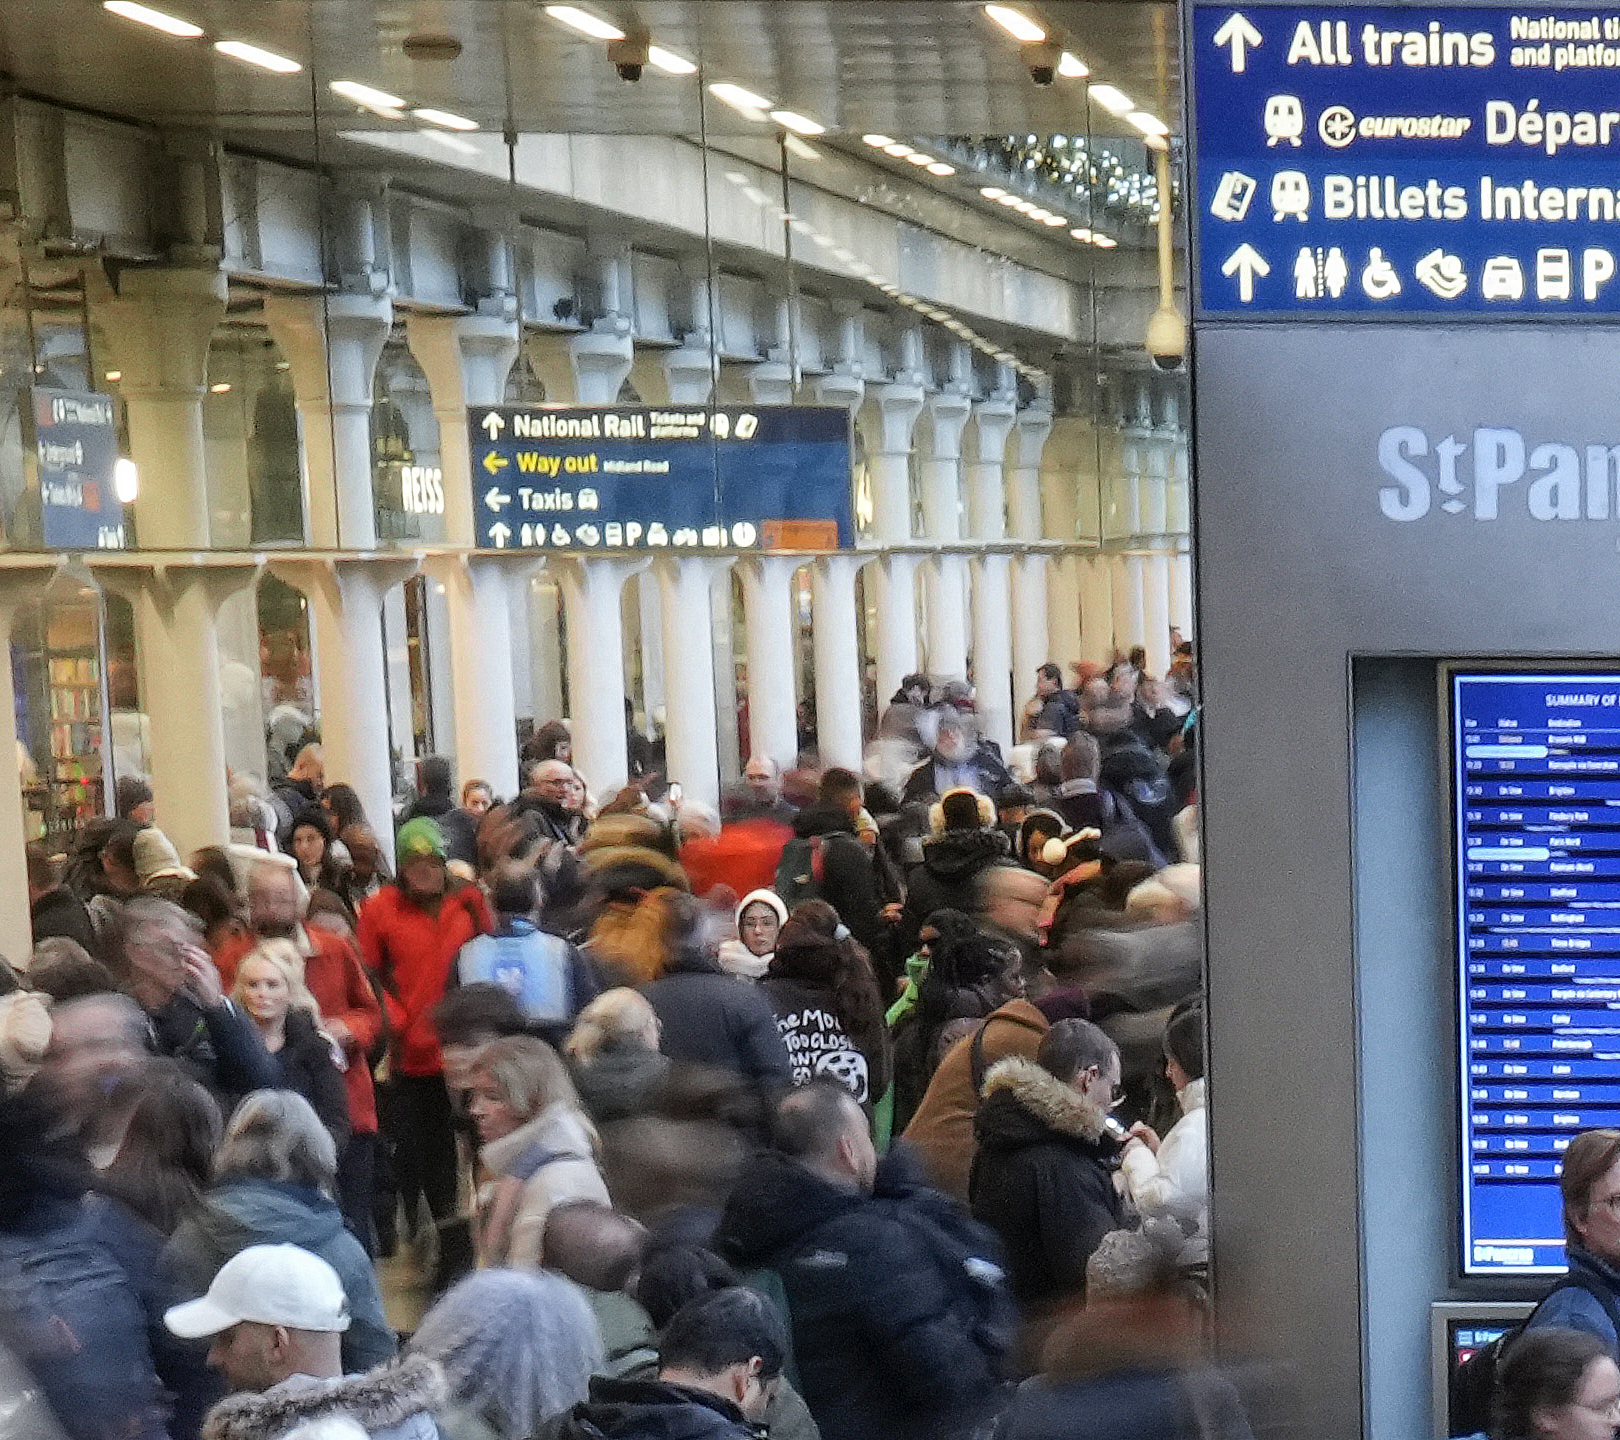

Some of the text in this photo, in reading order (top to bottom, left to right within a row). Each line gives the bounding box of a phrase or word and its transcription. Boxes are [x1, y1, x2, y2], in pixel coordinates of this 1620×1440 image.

[1510, 17, 1600, 41] National
[1287, 20, 1495, 66] All trains
[1510, 46, 1551, 66] and
[1323, 175, 1468, 221] Billets
[514, 414, 645, 438] National Rail
[517, 452, 598, 478] Way out
[402, 467, 444, 514] REISS
[518, 487, 573, 511] Taxis
[1546, 694, 1599, 707] SUMMARY
[1601, 694, 1617, 706] OF
